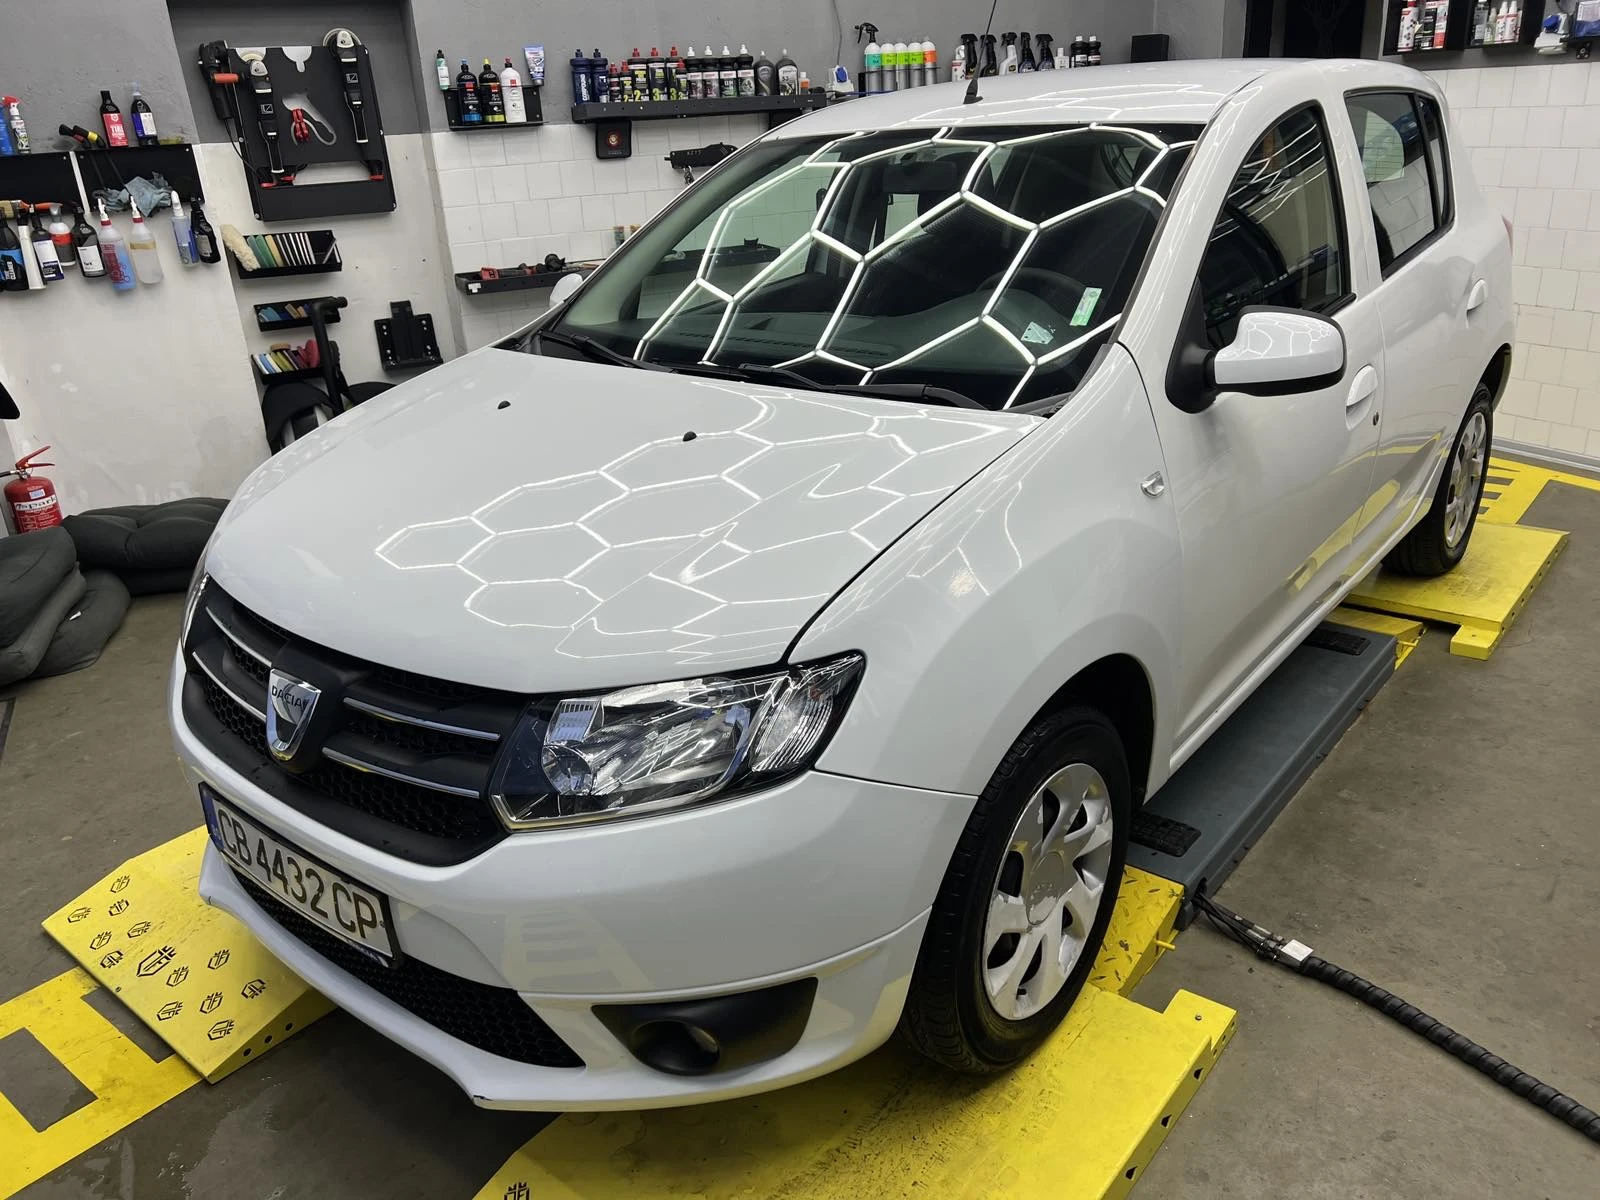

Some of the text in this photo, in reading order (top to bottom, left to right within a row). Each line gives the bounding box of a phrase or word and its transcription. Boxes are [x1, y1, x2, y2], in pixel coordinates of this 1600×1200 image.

[271, 685, 302, 708] DACIA
[218, 809, 378, 939] CB 4432 CP
